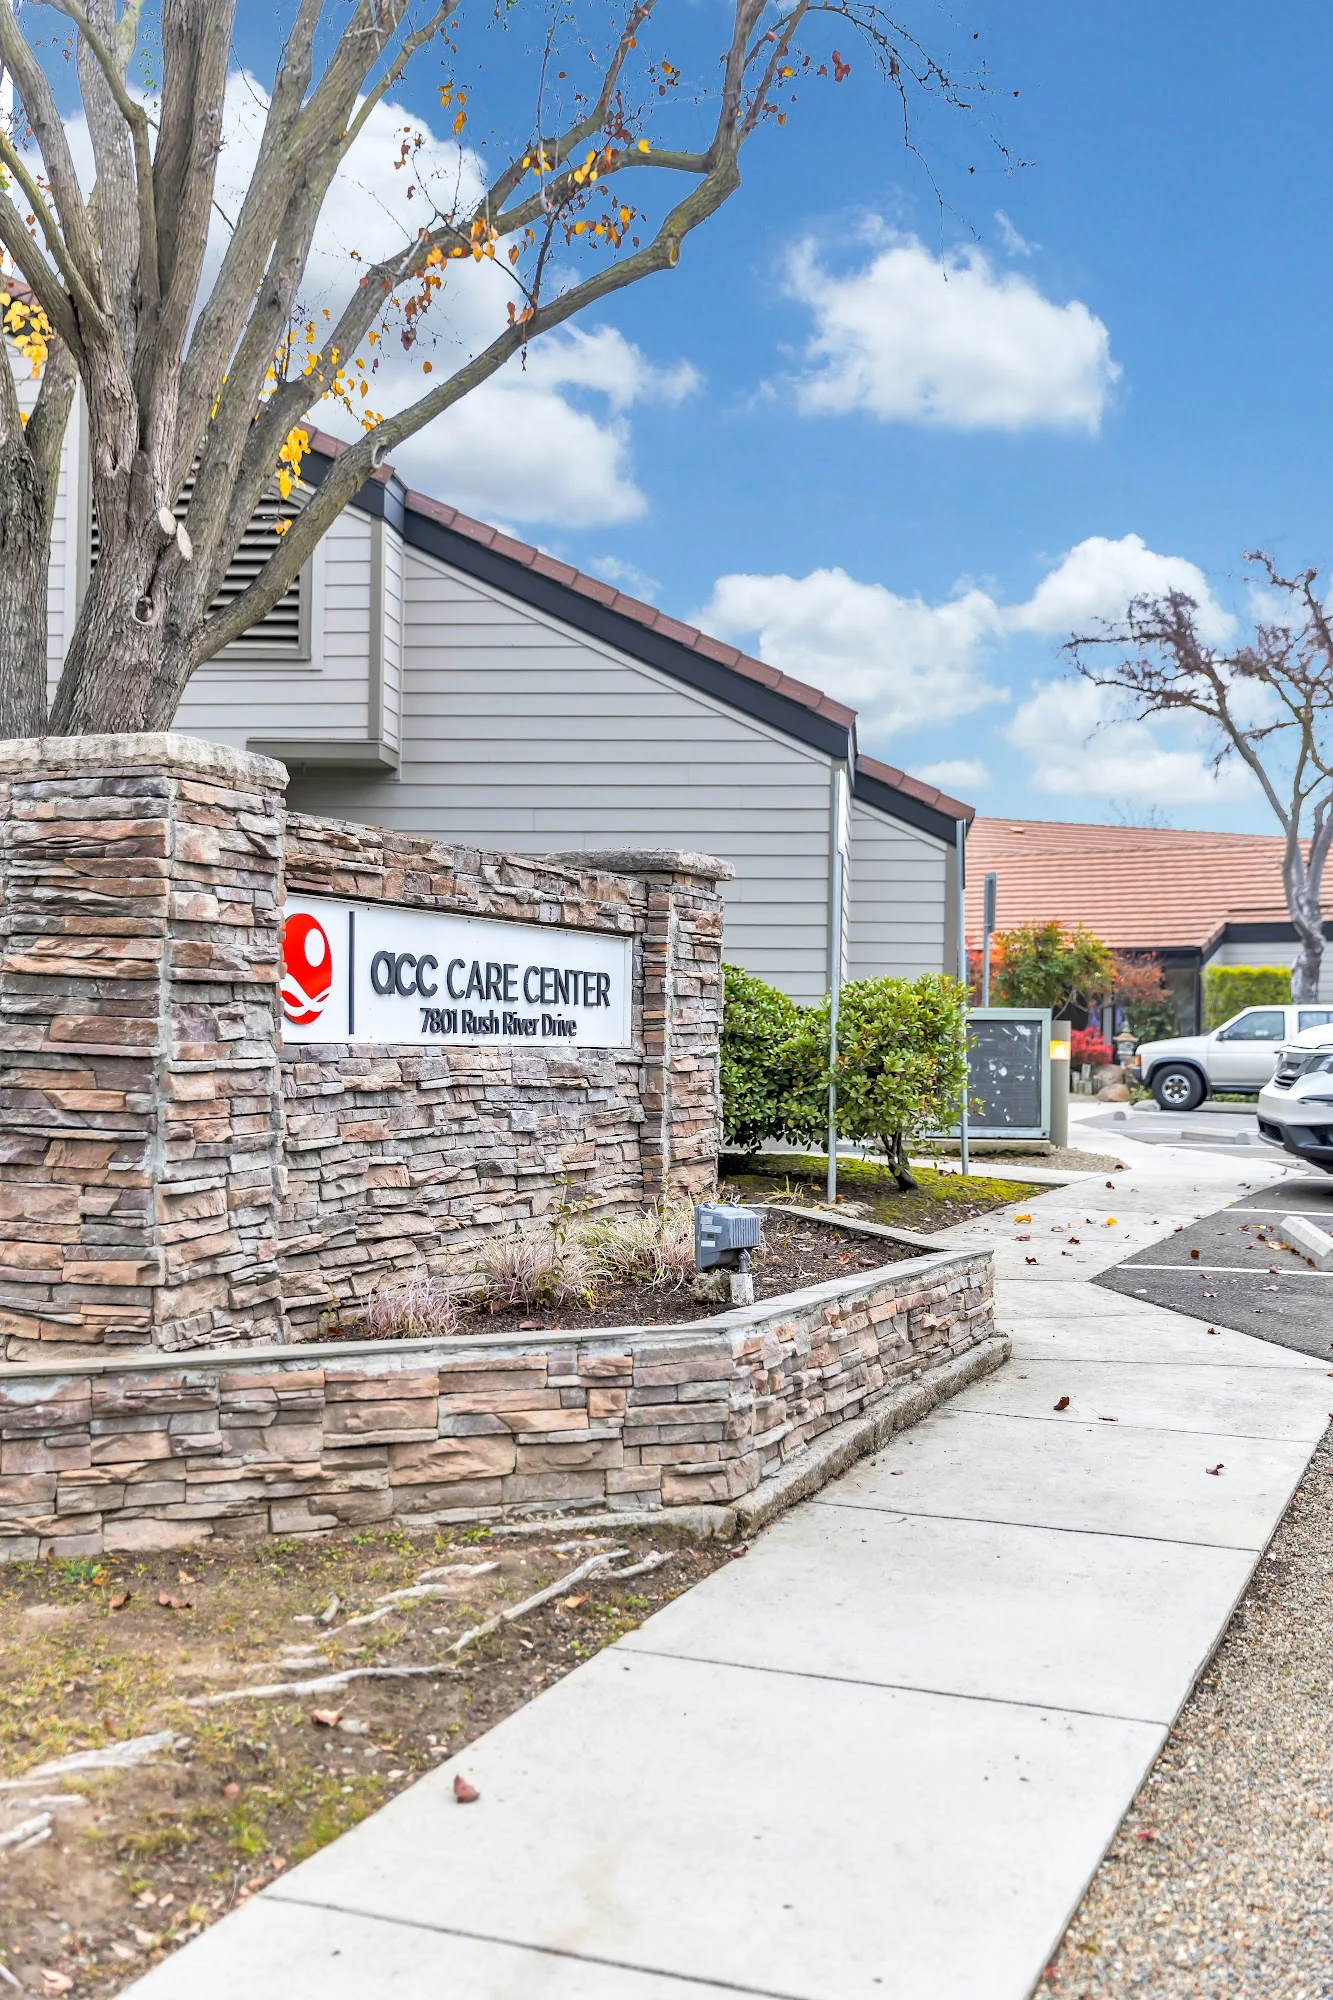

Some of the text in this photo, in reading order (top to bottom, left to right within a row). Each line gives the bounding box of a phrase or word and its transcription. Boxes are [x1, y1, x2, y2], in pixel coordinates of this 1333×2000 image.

[447, 958, 518, 1001] CARE
[524, 965, 611, 1007] CENTER
[420, 1007, 577, 1037] 7801 Rush River Drive
